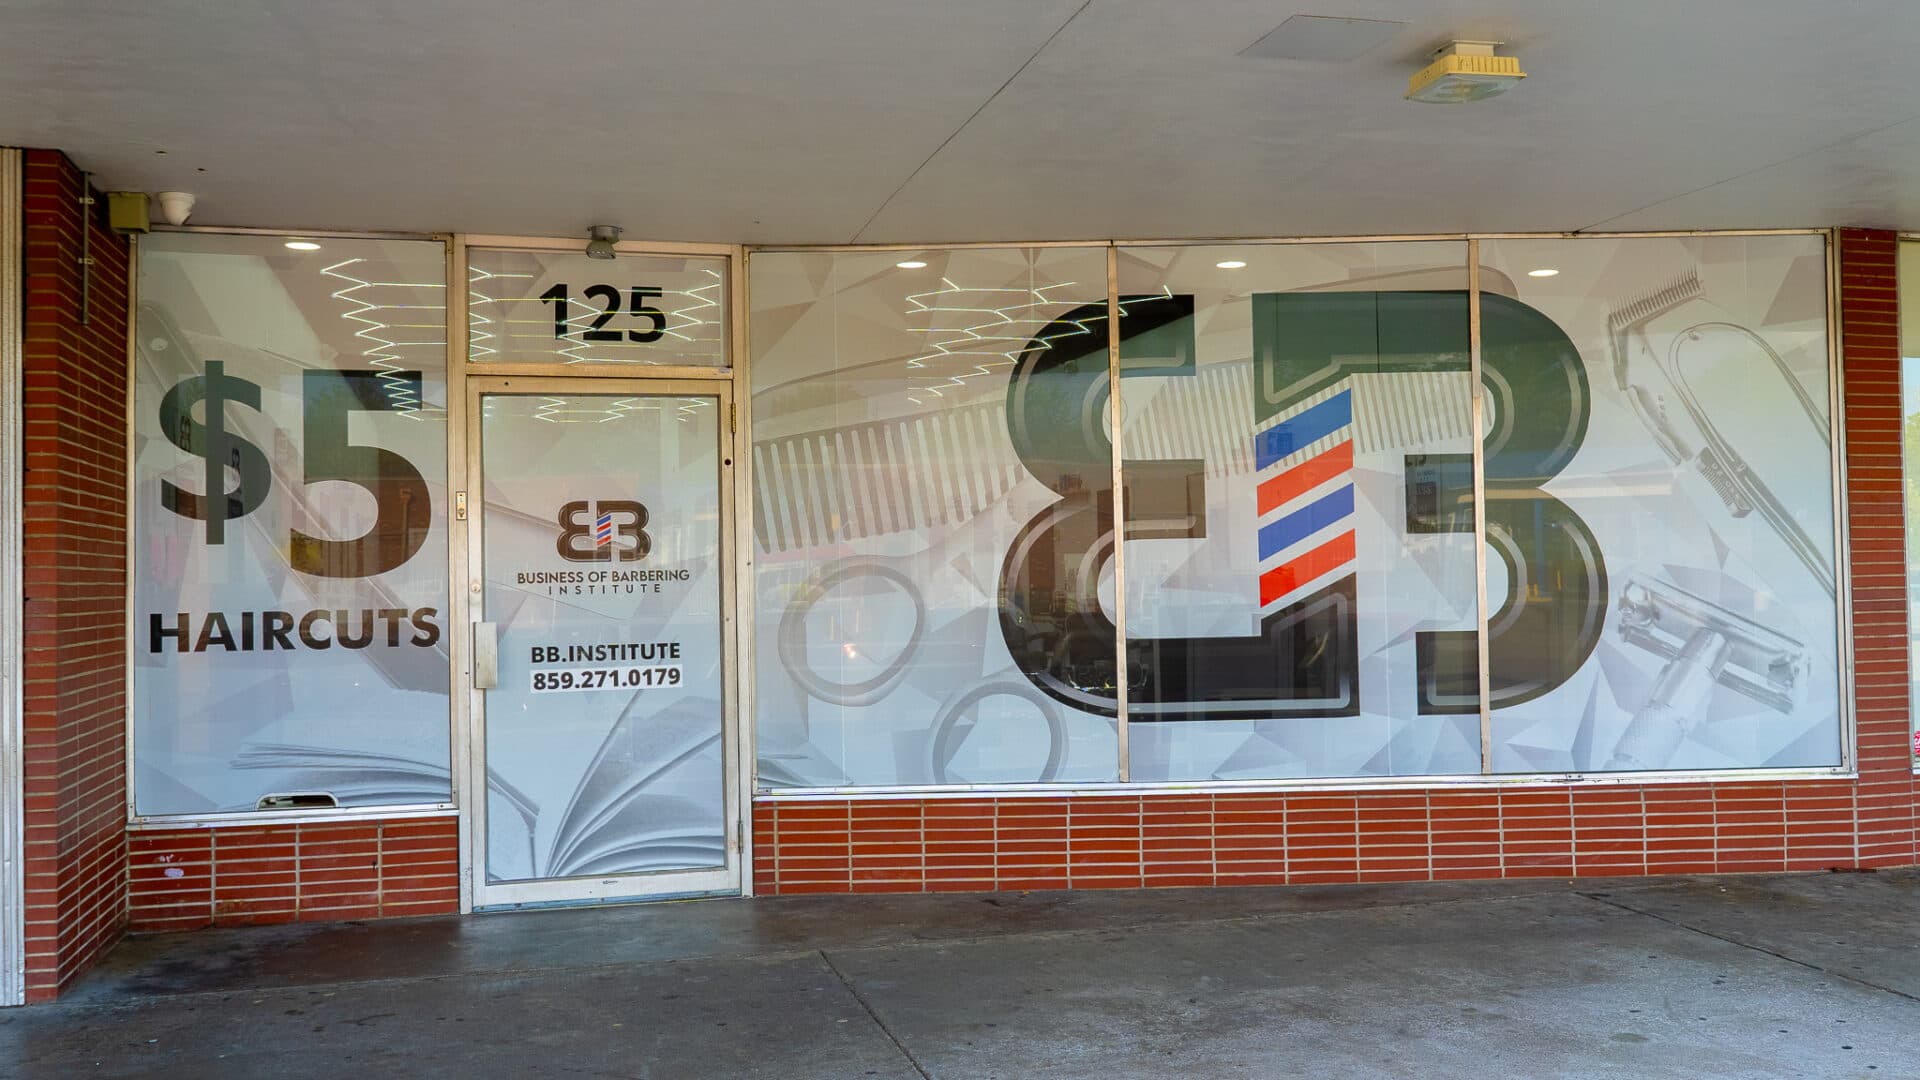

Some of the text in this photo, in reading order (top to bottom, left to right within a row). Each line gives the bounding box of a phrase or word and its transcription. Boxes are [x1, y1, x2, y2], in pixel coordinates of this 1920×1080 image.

[540, 283, 666, 343] 125
[159, 360, 432, 579] $5
[517, 569, 690, 584] BUSINESS OF BARBERING
[549, 583, 661, 595] INSTITUTE
[149, 606, 441, 654] HAIRCUTS
[531, 643, 681, 664] BB.INSTITUTE
[533, 667, 681, 690] 859.271.0179
